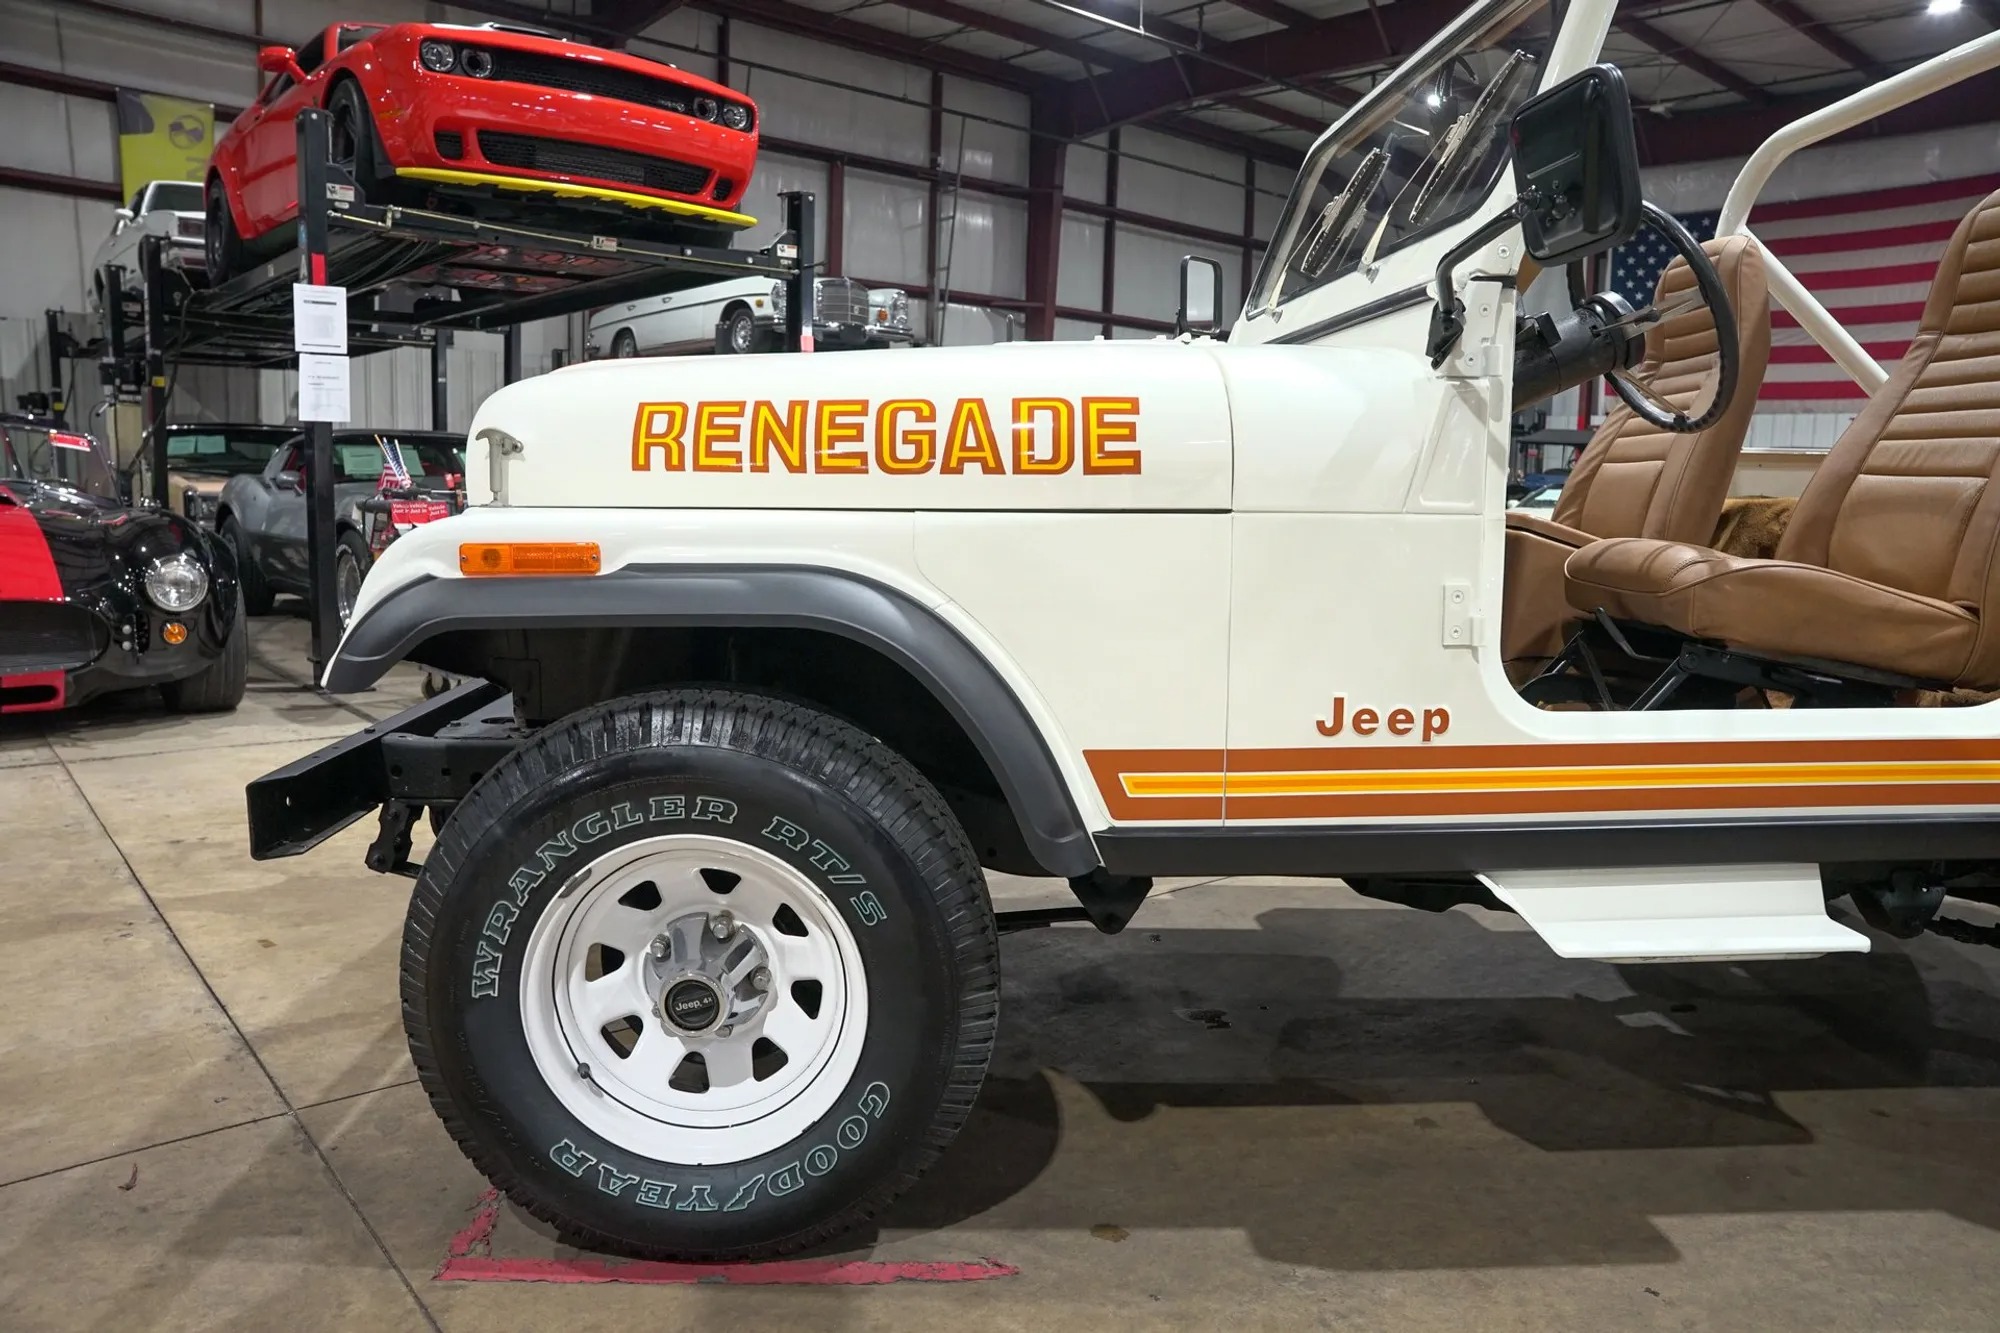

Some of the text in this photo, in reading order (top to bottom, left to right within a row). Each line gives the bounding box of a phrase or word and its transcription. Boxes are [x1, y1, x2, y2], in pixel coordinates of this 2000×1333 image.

[631, 396, 1142, 475] RENEGADE
[1315, 696, 1451, 743] Jeep
[471, 795, 888, 999] WRANGLER RT/S
[549, 1081, 891, 1212] GOODYEAR
